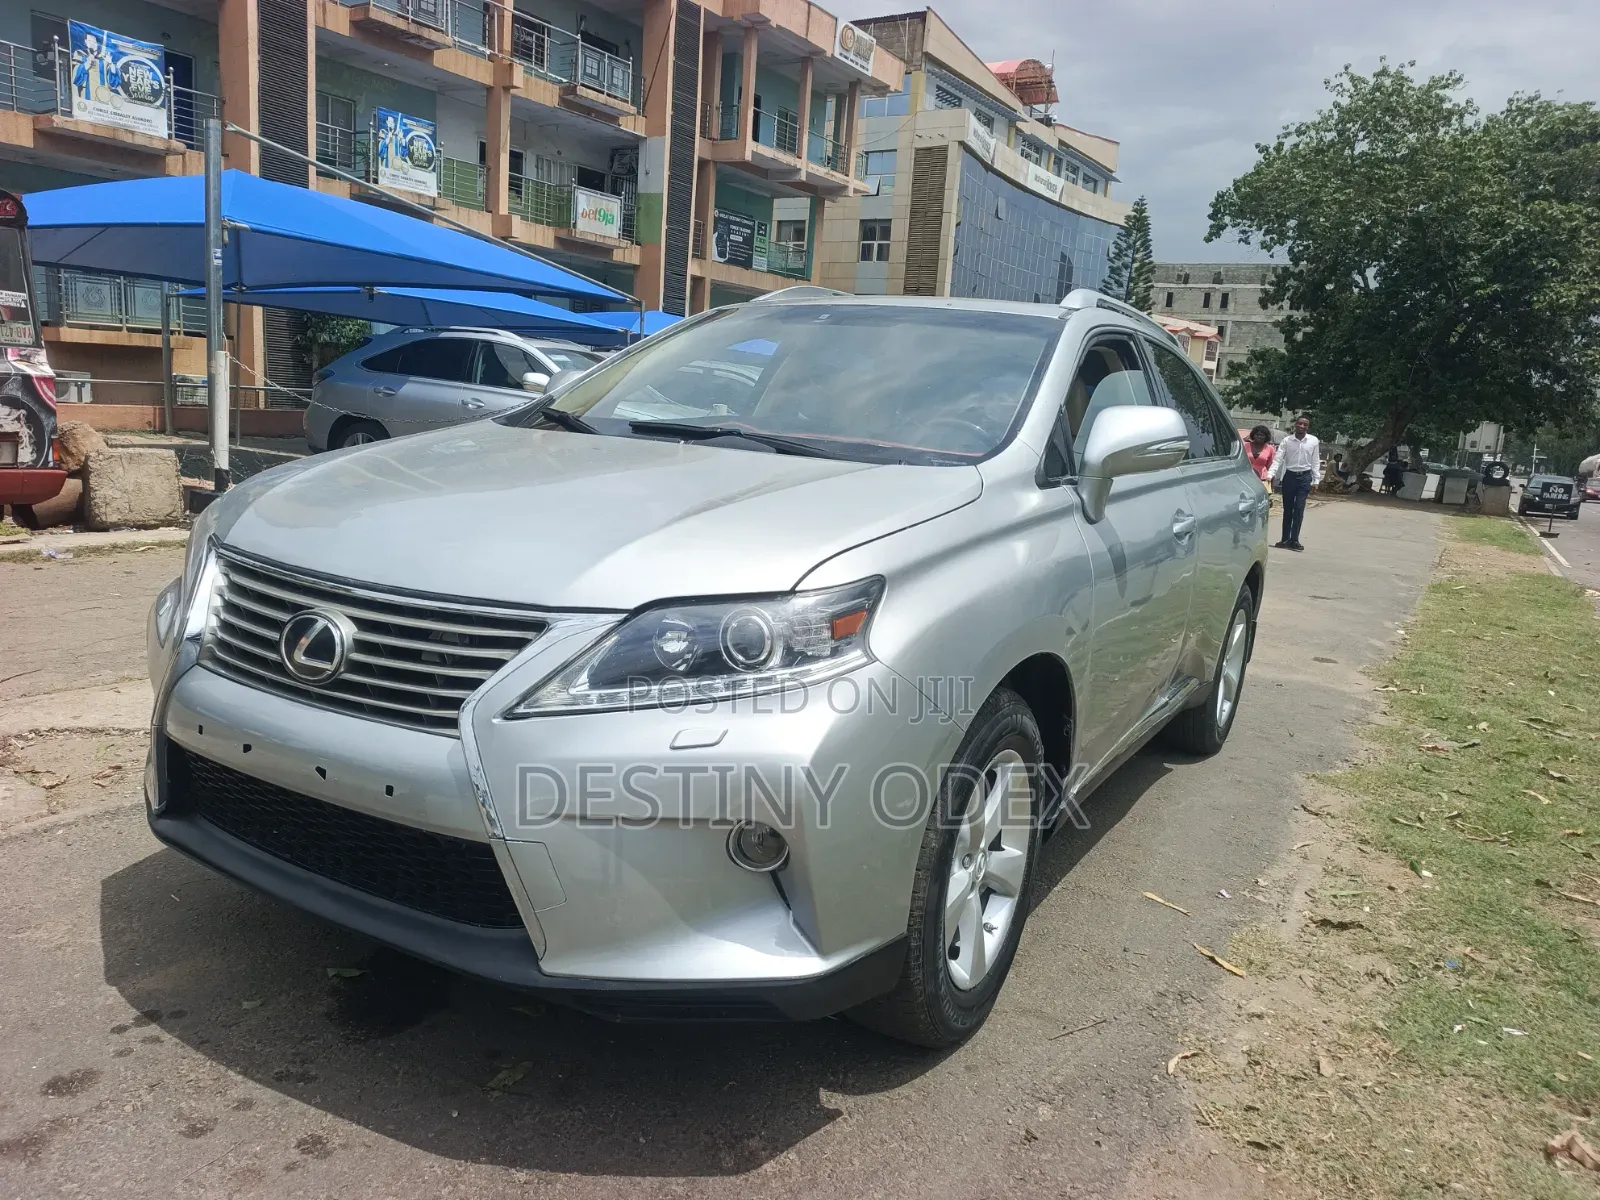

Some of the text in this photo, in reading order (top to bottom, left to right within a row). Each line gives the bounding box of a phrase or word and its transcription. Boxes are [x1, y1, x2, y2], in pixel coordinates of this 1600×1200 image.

[129, 66, 153, 81] NEW
[122, 72, 160, 89] YEAR'S
[131, 82, 152, 95] EVE
[1542, 492, 1569, 500] PARKING
[1549, 485, 1565, 494] NO
